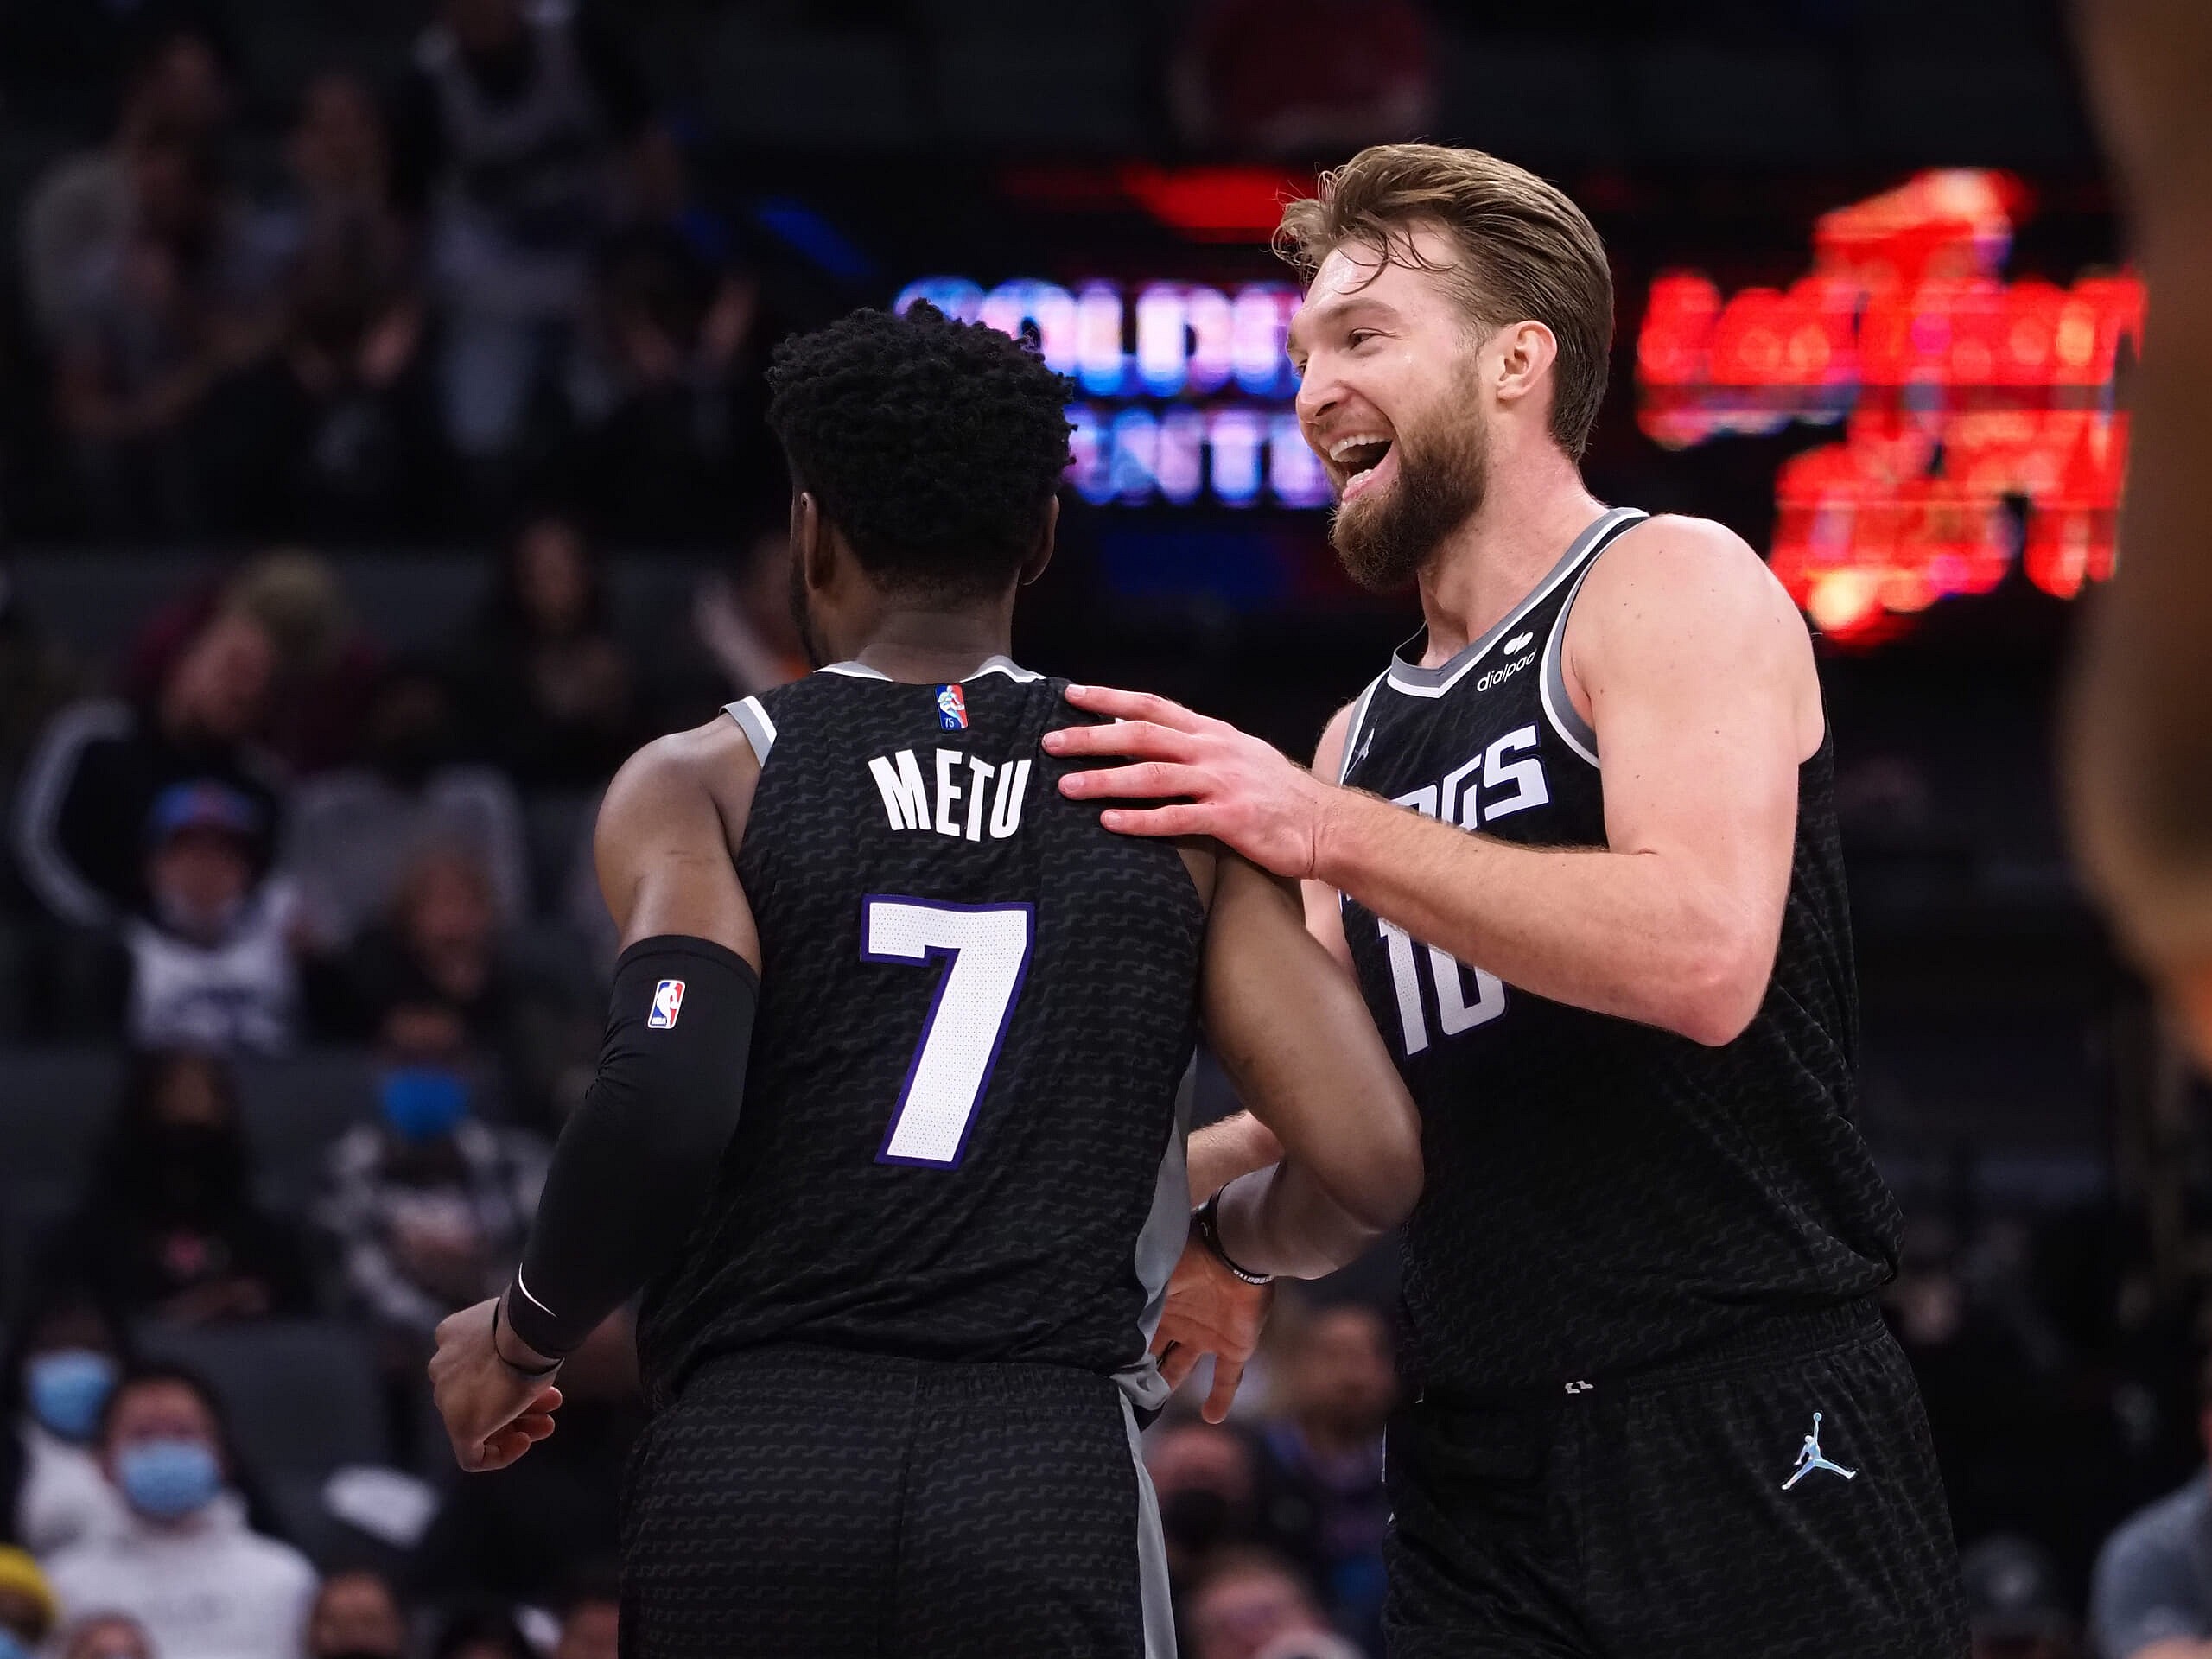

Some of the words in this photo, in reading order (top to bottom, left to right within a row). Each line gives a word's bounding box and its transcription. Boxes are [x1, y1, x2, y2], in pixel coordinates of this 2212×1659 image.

[1476, 647, 1537, 692] dialpad
[868, 747, 1032, 842] METU
[864, 899, 1031, 1166] 7
[1376, 916, 1507, 1056] 10
